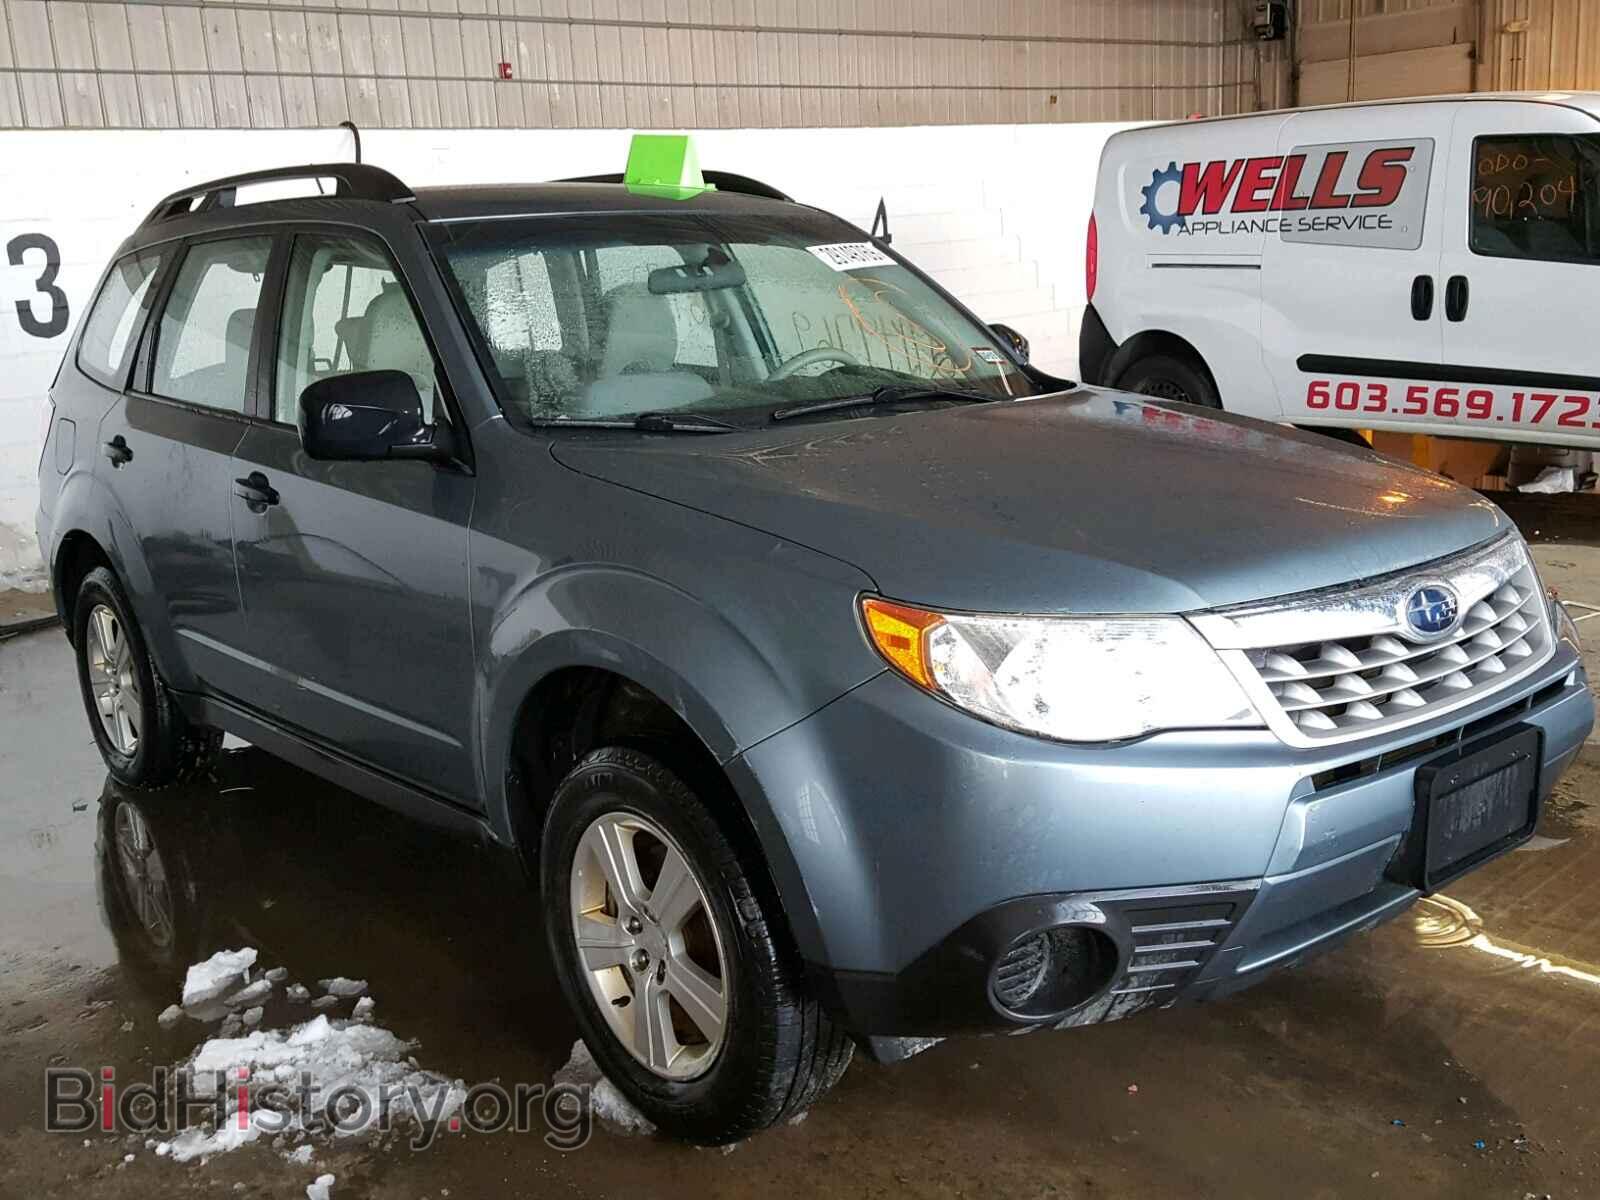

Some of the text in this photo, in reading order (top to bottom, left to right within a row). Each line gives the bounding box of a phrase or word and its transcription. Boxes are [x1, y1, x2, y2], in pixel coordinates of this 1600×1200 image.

[1177, 146, 1416, 216] WELLS
[1178, 213, 1393, 237] APPLIANCE SERVICE
[6, 232, 70, 339] 3
